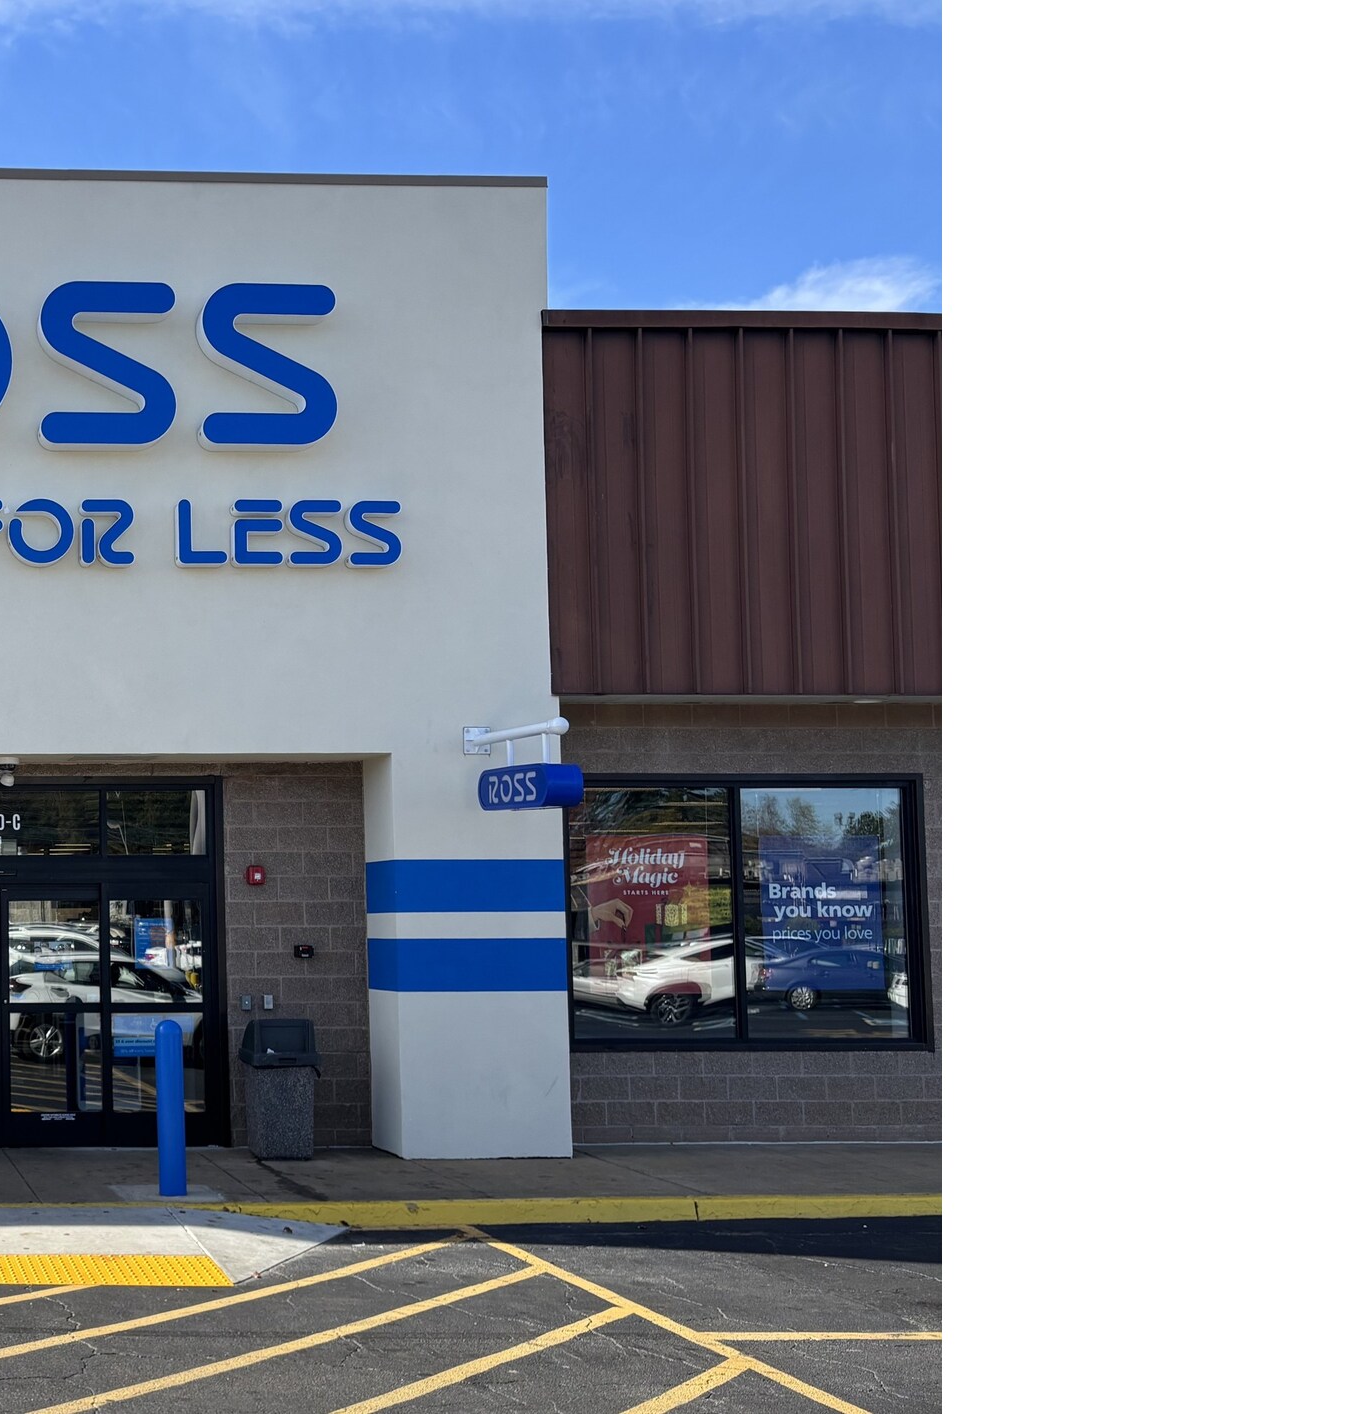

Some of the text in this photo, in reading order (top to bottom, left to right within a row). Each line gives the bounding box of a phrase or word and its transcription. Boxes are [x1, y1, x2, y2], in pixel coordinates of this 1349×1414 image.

[179, 500, 401, 564] LESS
[489, 771, 536, 803] ROSS
[607, 847, 685, 869] Holiday
[612, 866, 678, 888] Magic
[769, 882, 837, 899] Brands
[773, 901, 873, 922] you know
[772, 926, 873, 943] prices you love
